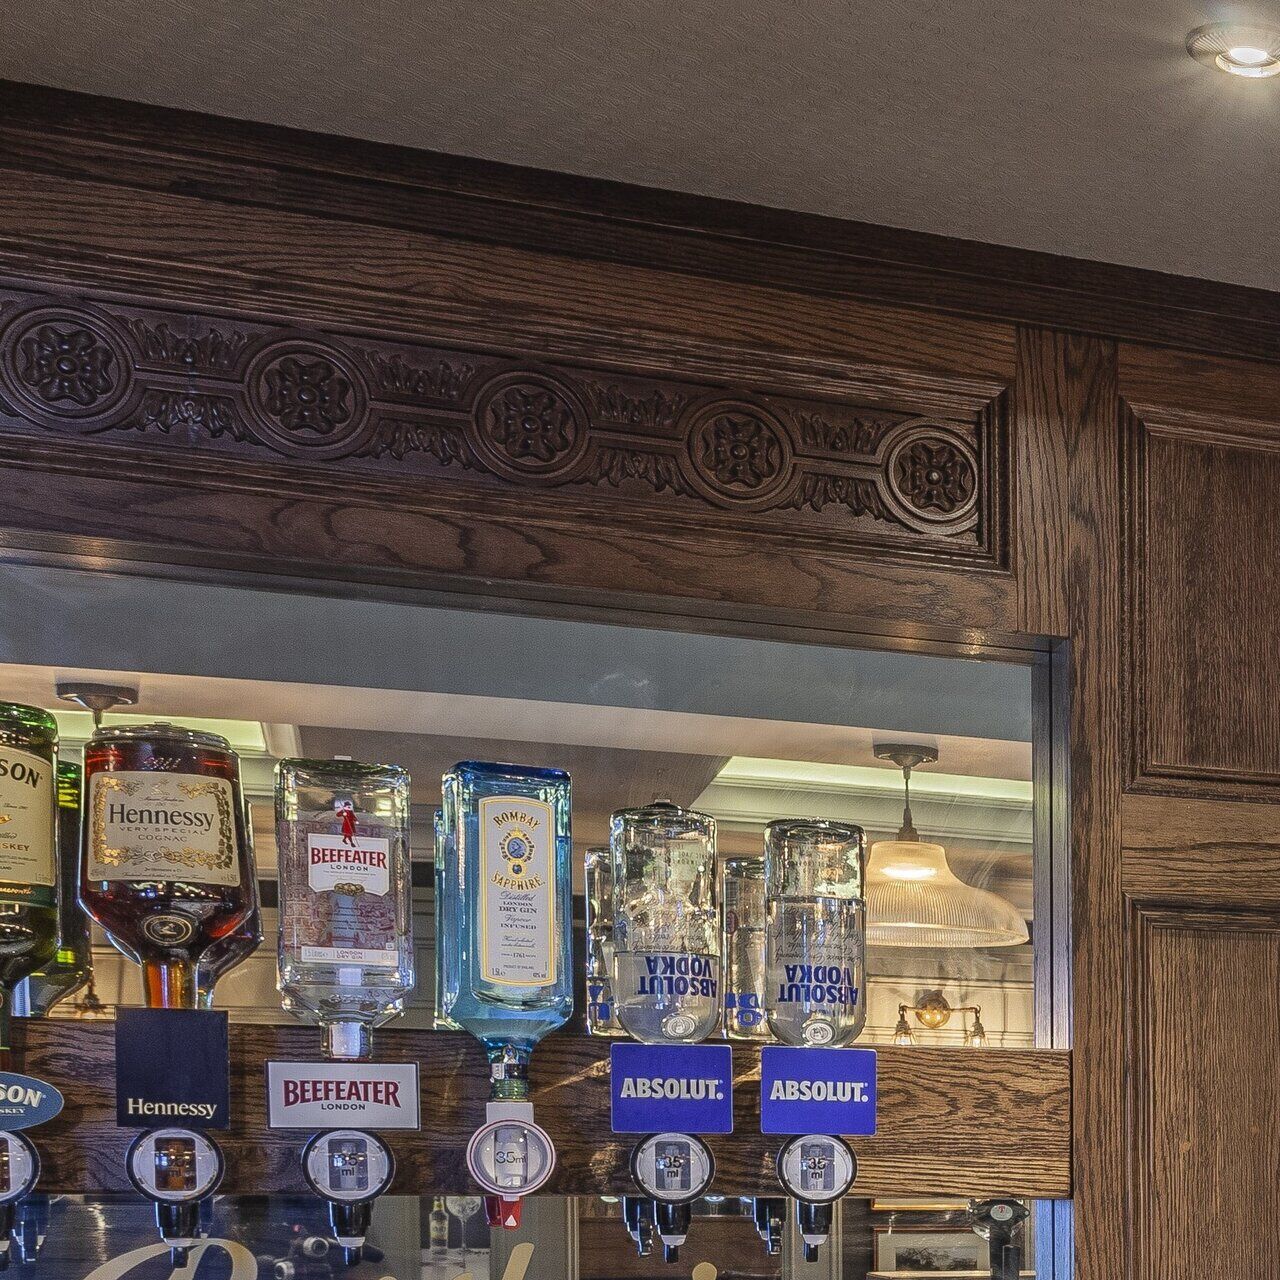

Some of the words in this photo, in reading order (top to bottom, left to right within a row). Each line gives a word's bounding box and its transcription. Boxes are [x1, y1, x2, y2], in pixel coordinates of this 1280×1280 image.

[0, 758, 40, 789] SON
[109, 803, 215, 832] Hennessy
[493, 811, 541, 831] BOMBAY
[138, 834, 188, 843] COGNAC
[154, 827, 205, 836] SPECIAL
[311, 847, 388, 870] BEEFEATER
[330, 864, 369, 872] LONDON
[491, 871, 543, 891] SAPPHIRE
[499, 890, 536, 901] Distilled
[645, 955, 712, 978] VODKA
[784, 965, 852, 985] VODKA
[637, 975, 718, 998] ABSOLUT
[778, 983, 860, 1006] ABSOLUT
[0, 1085, 42, 1108] SON
[283, 1080, 402, 1108] BEEFEATER
[127, 1098, 217, 1120] Hennessy
[321, 1102, 366, 1111] LONDON
[341, 1167, 355, 1177] ml
[663, 1156, 682, 1169] 35
[807, 1157, 826, 1170] 35
[666, 1169, 679, 1178] ml
[811, 1169, 823, 1179] ml
